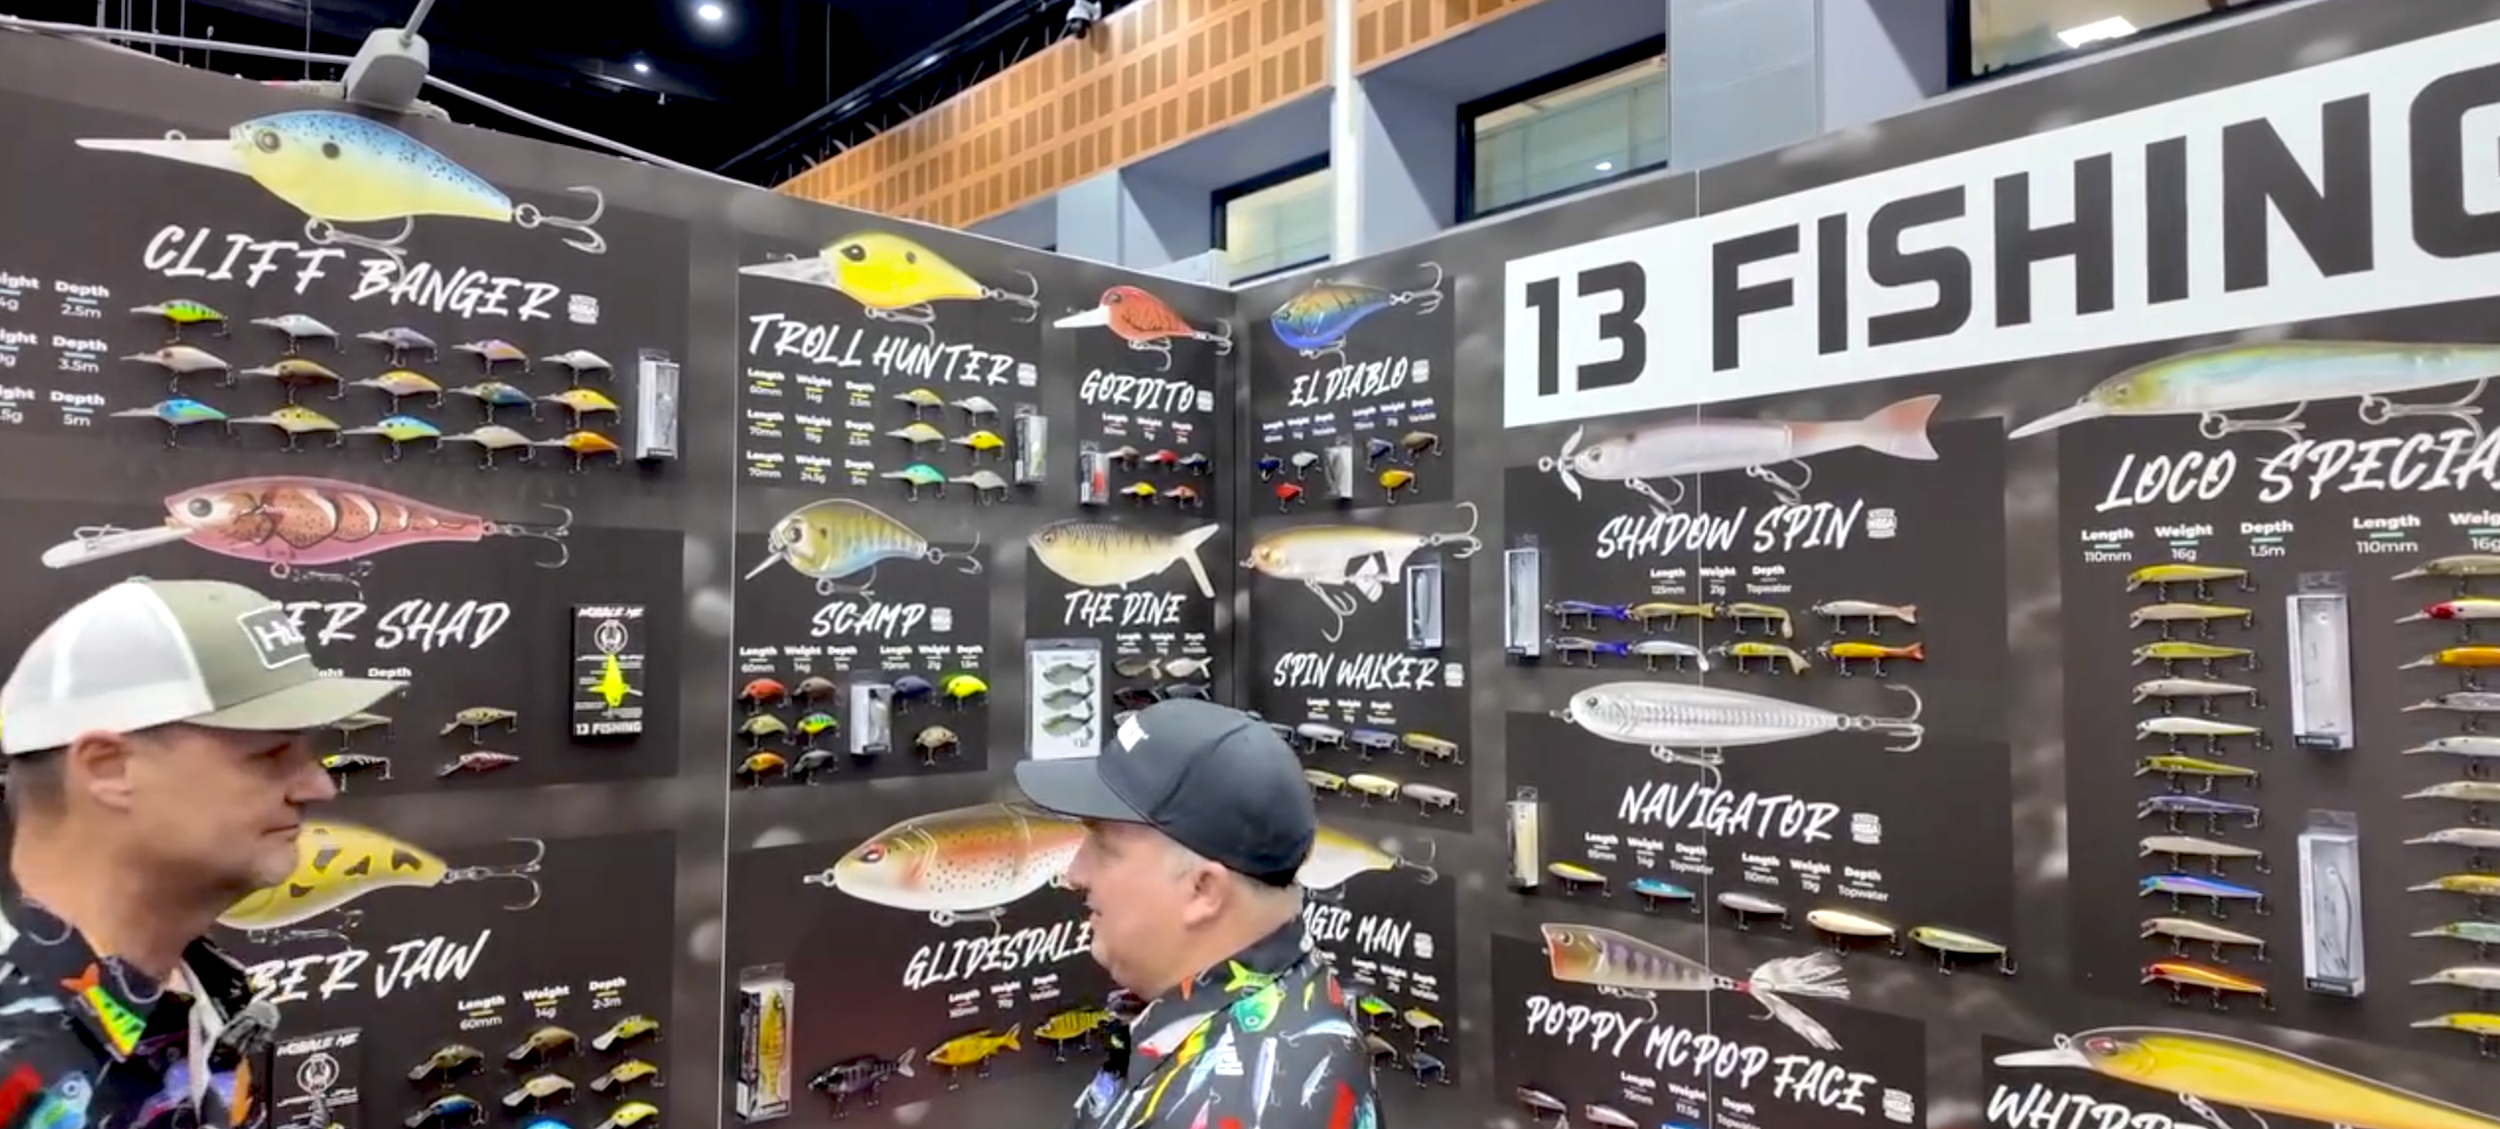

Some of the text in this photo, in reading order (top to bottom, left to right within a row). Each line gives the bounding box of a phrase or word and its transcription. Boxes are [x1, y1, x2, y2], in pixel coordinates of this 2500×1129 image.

[1524, 62, 2500, 397] 13 FISHING
[54, 280, 110, 298] Depth
[143, 224, 561, 322] CLIFF BANGER
[61, 303, 102, 318] 2.5m
[0, 328, 108, 352] ight Depth
[749, 313, 864, 367] TROLL
[872, 336, 1014, 386] HUNTER
[58, 358, 99, 373] 3.5m
[1287, 370, 1320, 407] EL
[1323, 356, 1408, 404] DIABLO
[0, 384, 106, 406] ight Depth
[1080, 368, 1195, 413] GORDITO
[63, 413, 91, 427] 5m
[2095, 425, 2500, 512] LOCO SPECIA
[1596, 498, 1864, 561] SHADOW SPIN
[2081, 520, 2294, 542] Length Weight Depth
[2352, 513, 2421, 530] Length
[2084, 545, 2285, 563] 110mm 16g 1.5m
[2356, 540, 2419, 554] 110mm
[1650, 564, 1785, 578] Length Weight Depth
[1745, 582, 1792, 595] Topwater
[810, 600, 927, 639] SCAMP
[1064, 589, 1187, 628] THE DINE
[375, 600, 510, 652] SHAD
[739, 645, 778, 657] Length
[783, 644, 822, 657] Weight
[367, 667, 412, 680] Depth
[1273, 652, 1335, 688] SPIN
[1336, 652, 1439, 691] WALKER
[591, 720, 642, 735] FISHING
[1616, 780, 1840, 843] NAVIGATOR
[1585, 832, 1708, 858] Length Weight Depth
[1669, 859, 1715, 876] Topwater
[1742, 852, 1882, 883] Length Weight Depth
[1744, 869, 1779, 886] 110mm
[1837, 884, 1889, 902] Topwater
[1356, 915, 1412, 958] MAN
[374, 929, 491, 999] JAW
[903, 920, 1091, 991] GLIDESDALE
[458, 976, 627, 1011] Length Weight Depth
[460, 1015, 502, 1030] 60mm
[535, 1006, 556, 1018] 14g
[1526, 995, 1878, 1115] POPPY MCPOP FACE
[1620, 1070, 1755, 1115] Length Weight Depth
